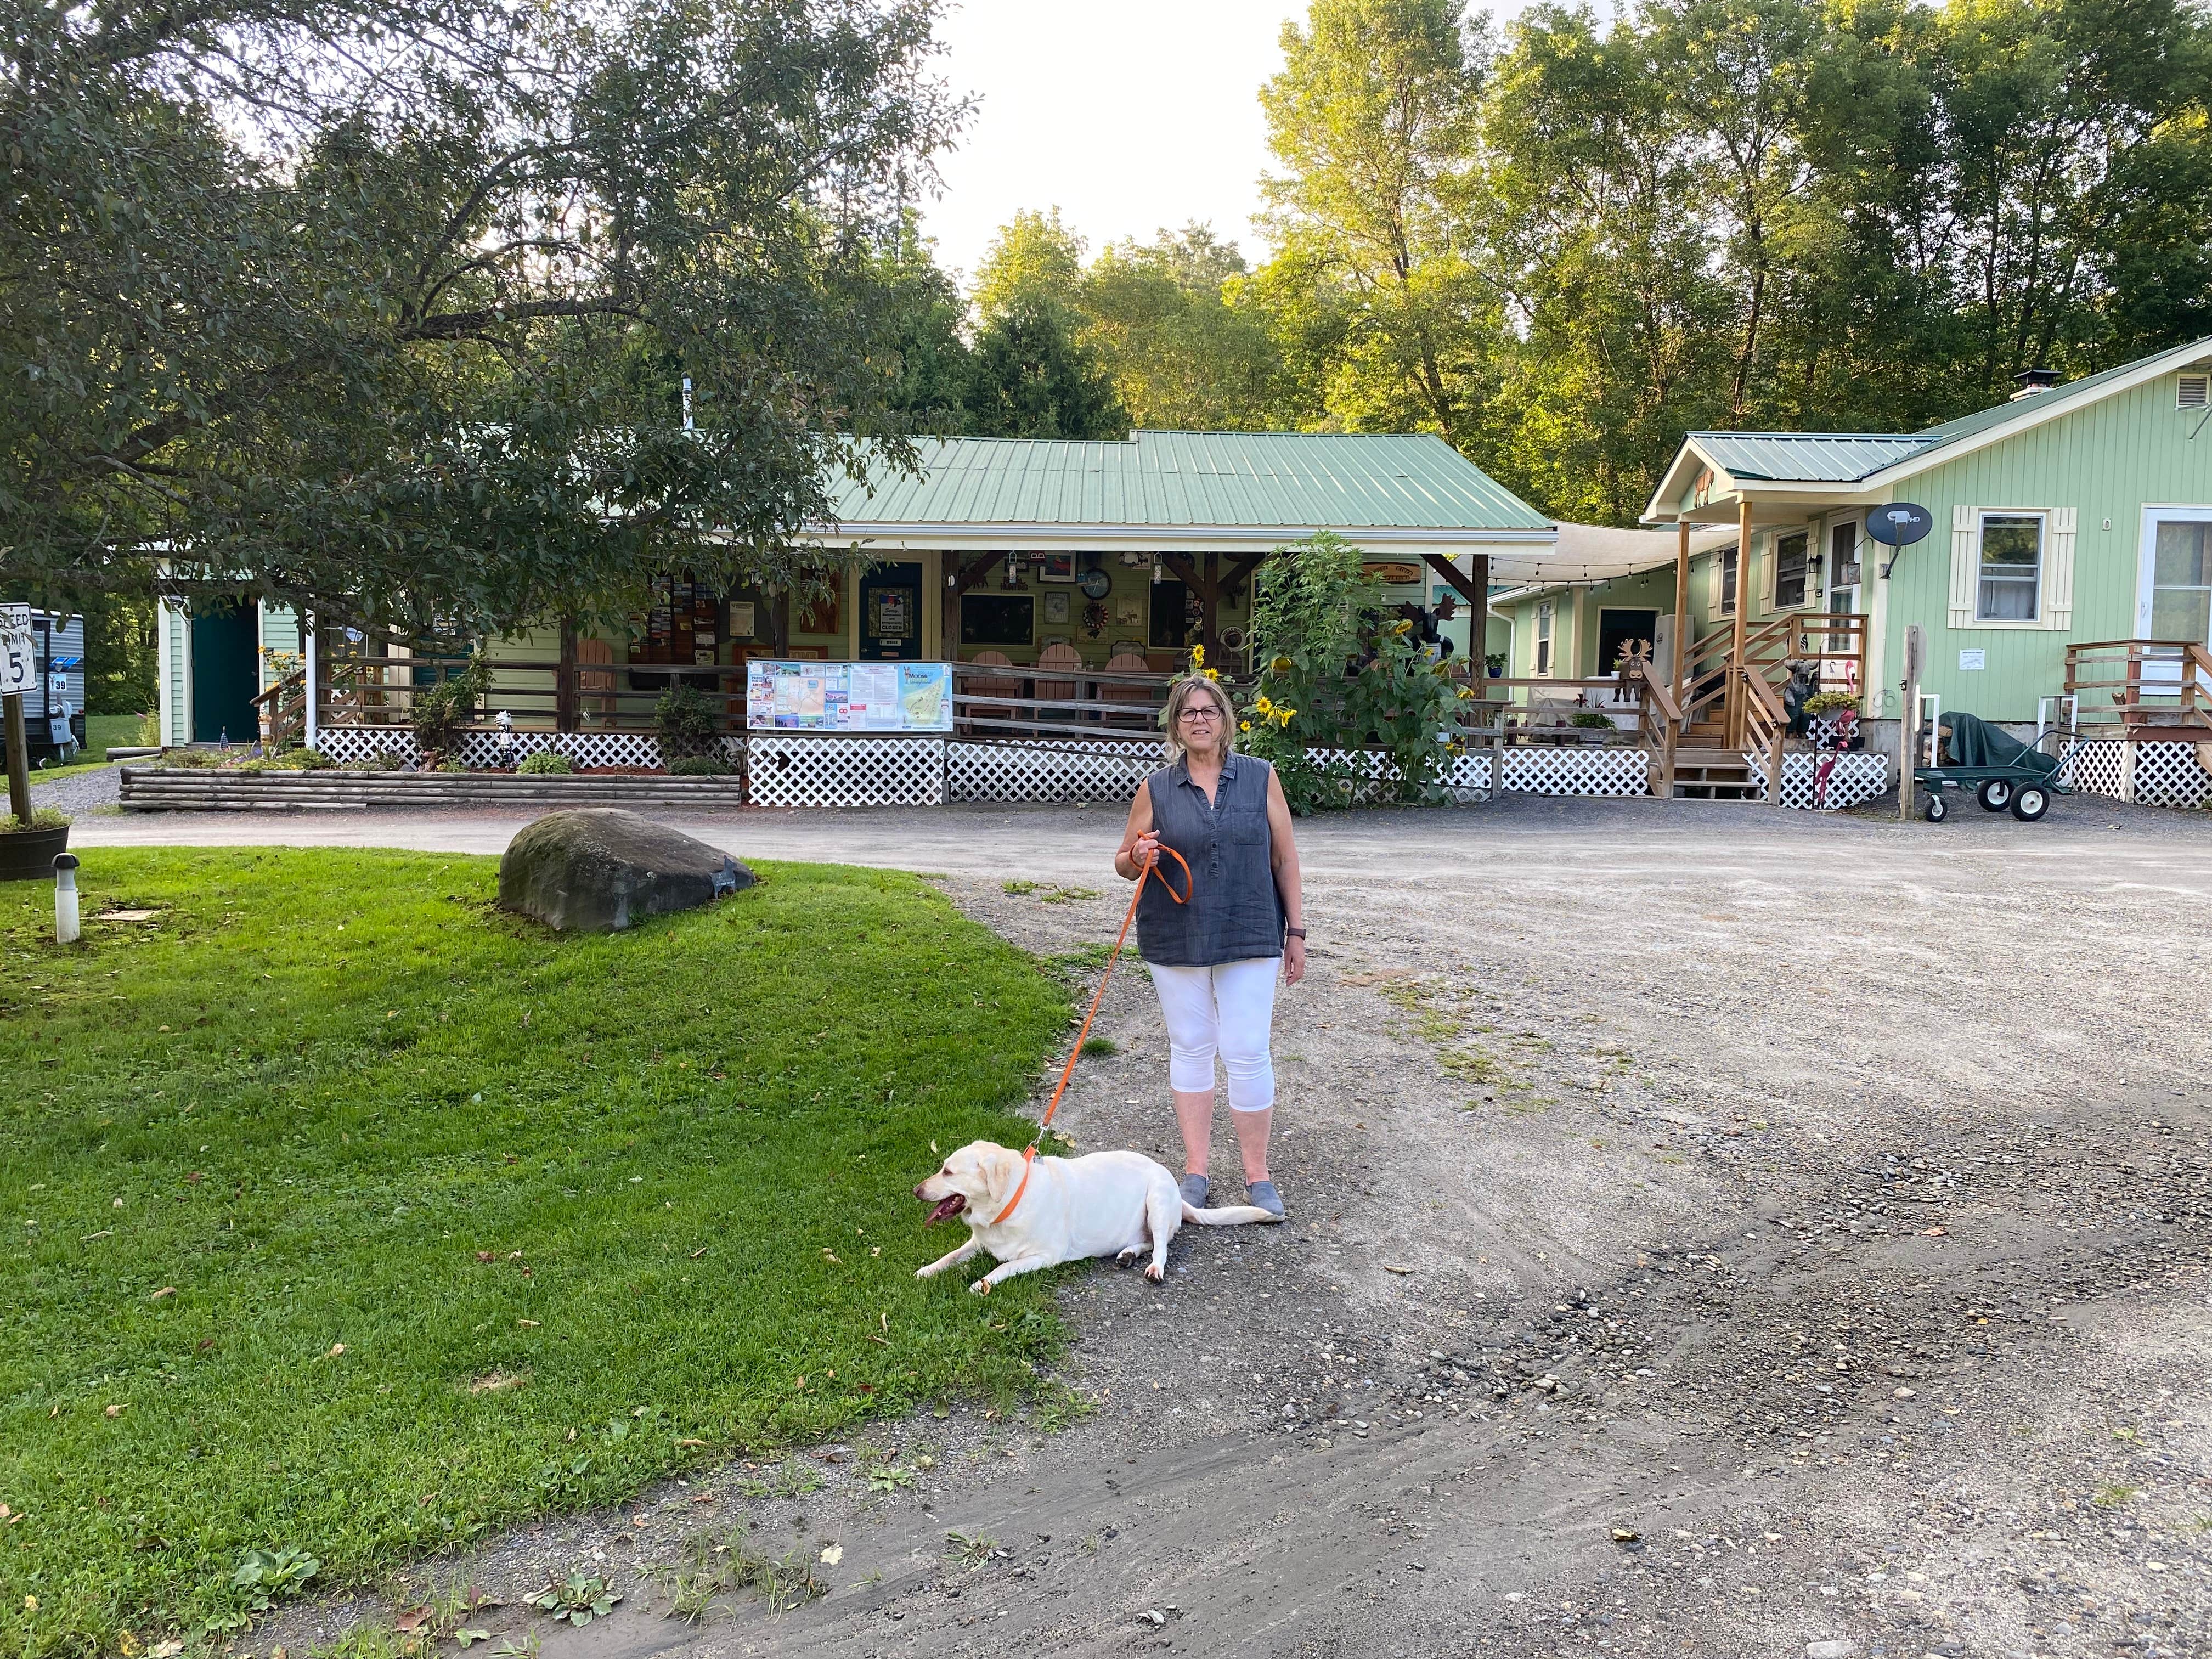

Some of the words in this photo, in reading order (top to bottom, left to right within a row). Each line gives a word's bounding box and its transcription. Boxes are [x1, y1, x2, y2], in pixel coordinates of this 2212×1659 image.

[1222, 627, 1243, 636] WELCOME
[9, 652, 24, 683] 5
[55, 681, 65, 690] 39
